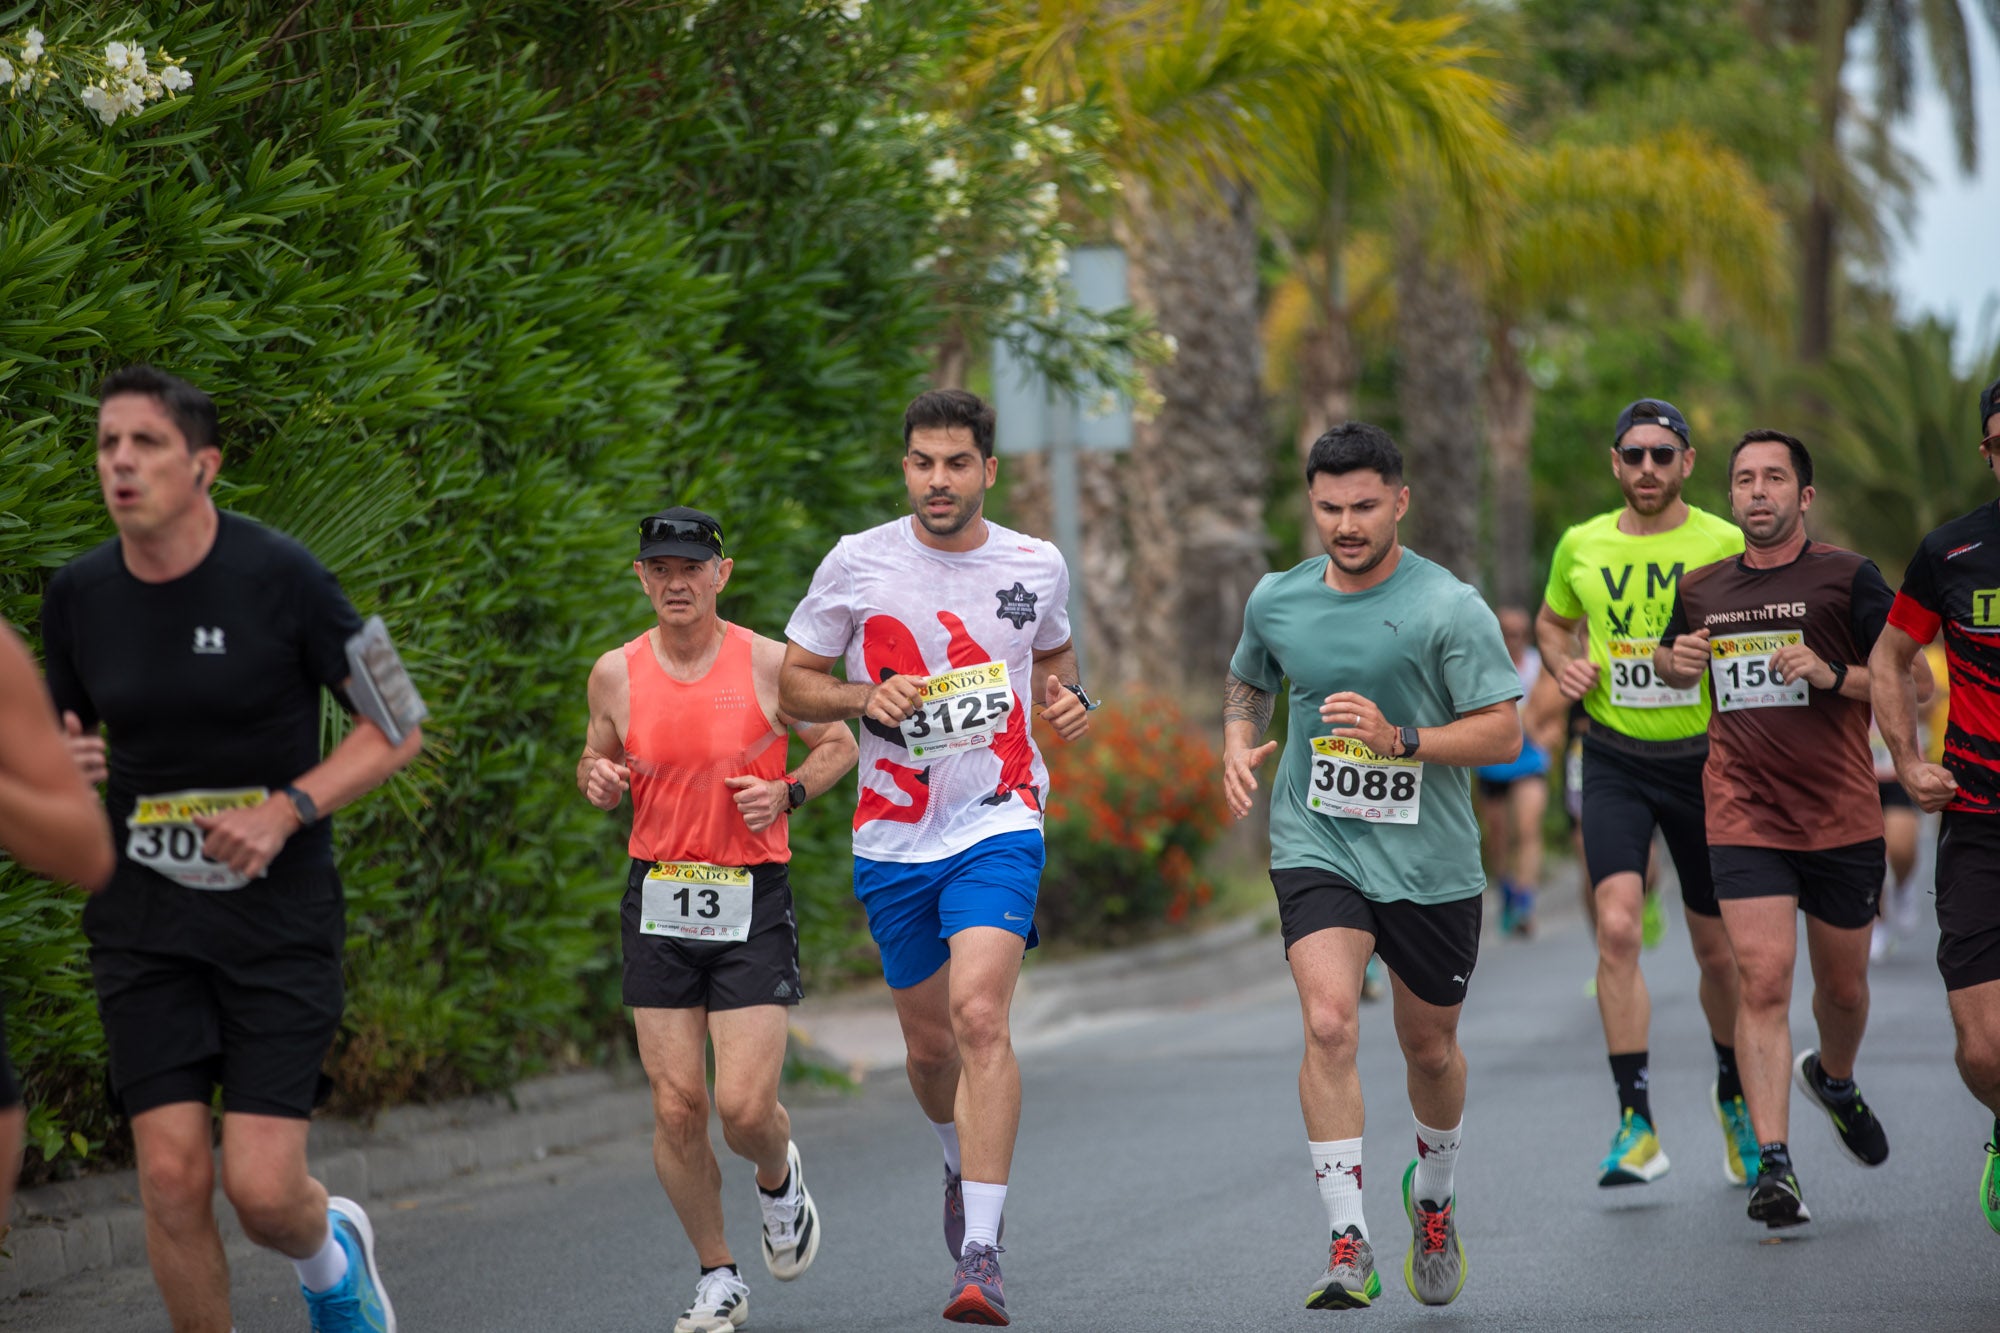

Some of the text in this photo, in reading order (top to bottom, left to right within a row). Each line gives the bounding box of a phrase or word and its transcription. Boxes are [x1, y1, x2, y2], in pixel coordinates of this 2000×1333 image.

[1722, 641, 1736, 653] 38
[928, 674, 985, 696] FONDO
[907, 691, 1010, 739] 3125
[1328, 739, 1346, 753] 38
[1314, 759, 1416, 802] 3088
[136, 826, 220, 863] 30
[661, 864, 729, 880] 38 FONDO
[673, 888, 721, 919] 13
